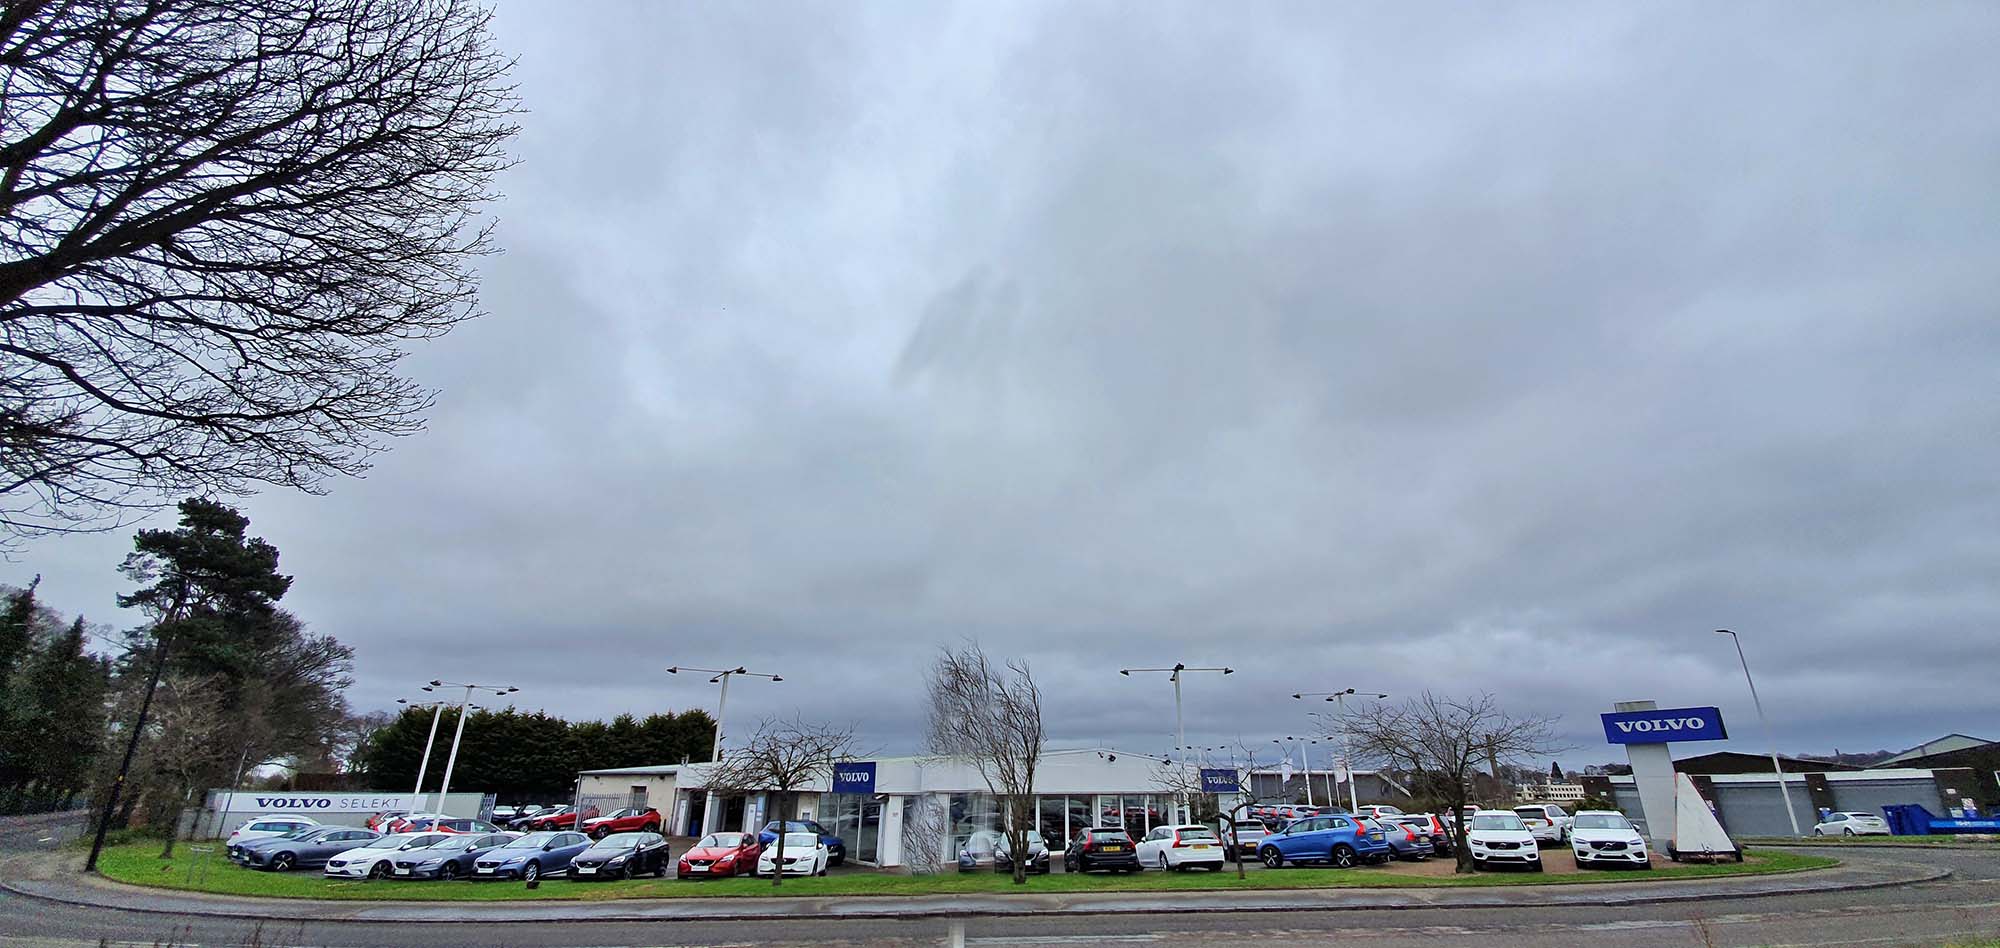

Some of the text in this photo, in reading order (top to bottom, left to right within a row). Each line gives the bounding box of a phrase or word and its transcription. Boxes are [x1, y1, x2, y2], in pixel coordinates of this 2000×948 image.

[1615, 717, 1704, 733] VOLVO
[839, 772, 869, 782] VOLVO
[256, 798, 400, 808] VOLVO SELEKT
